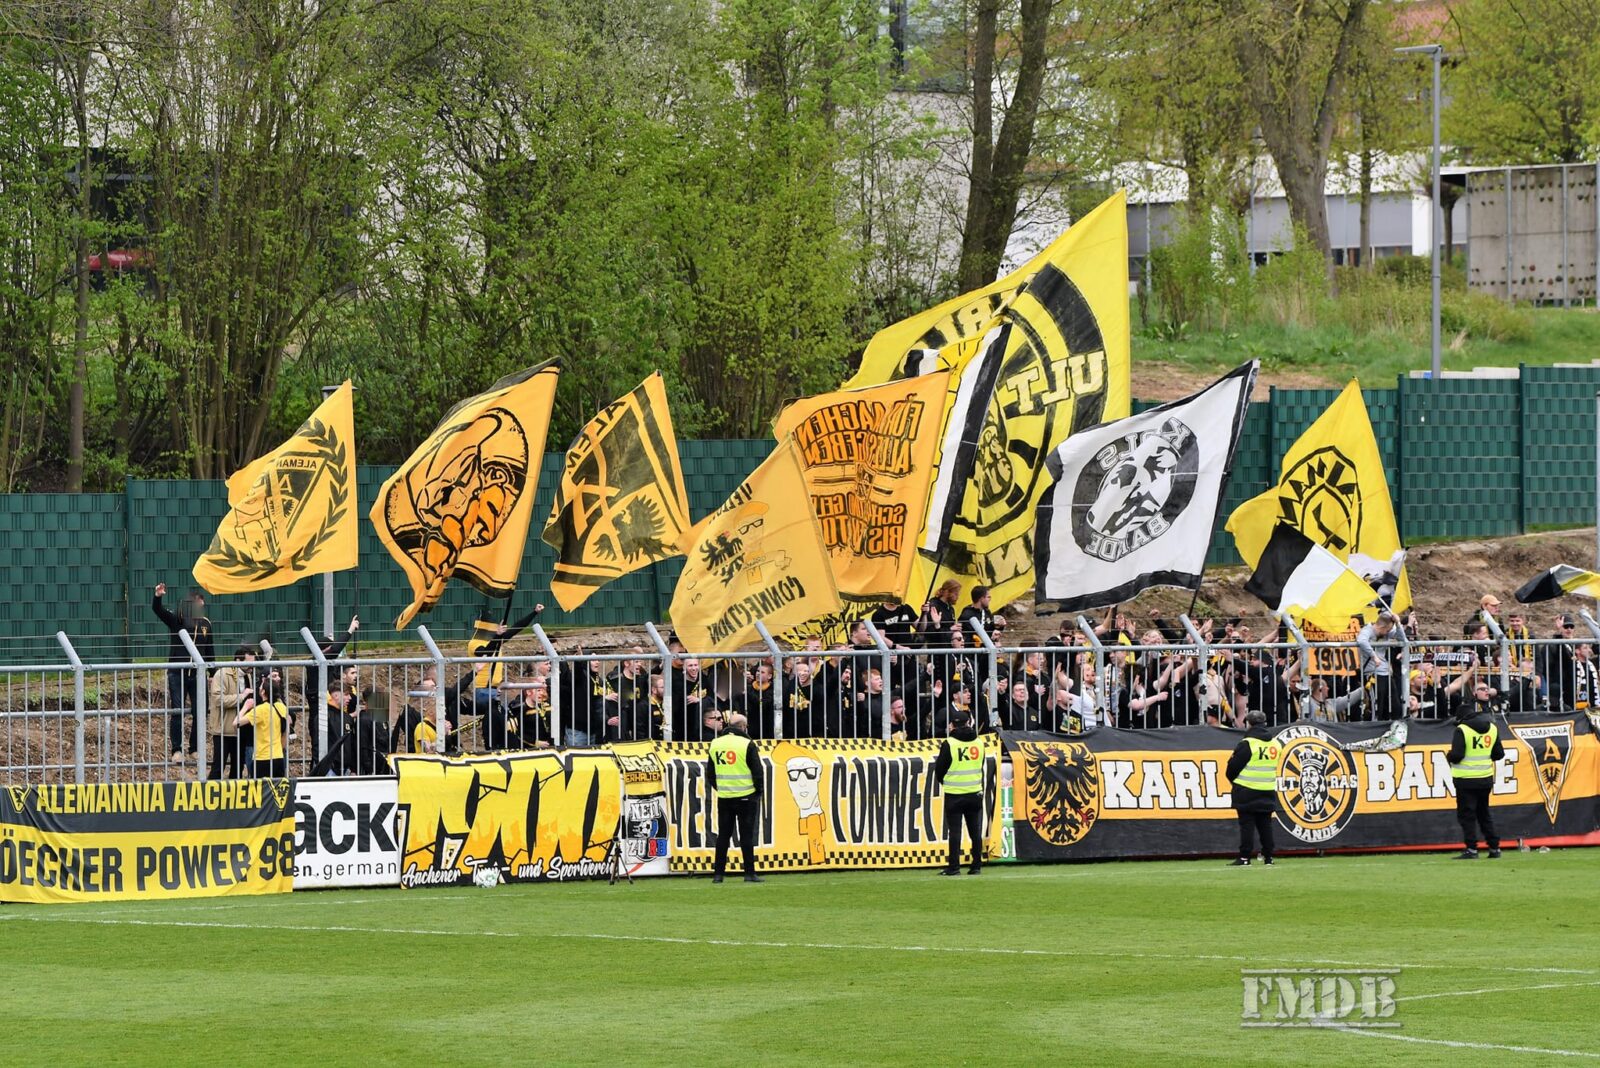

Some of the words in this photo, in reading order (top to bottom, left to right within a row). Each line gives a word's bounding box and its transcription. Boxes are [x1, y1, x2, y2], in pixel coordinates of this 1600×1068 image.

[1277, 726, 1328, 745] KARLS
[1472, 734, 1493, 749] K9
[715, 750, 737, 765] K9
[957, 745, 980, 762] K9
[1258, 746, 1278, 760] K9
[1329, 775, 1357, 790] RAS
[1364, 748, 1519, 802] BANE
[37, 782, 166, 814] ALEMANNIA
[173, 778, 263, 812] AACHEN
[1292, 822, 1340, 840] BANDE
[648, 837, 667, 857] RB
[136, 843, 252, 890] POWER
[259, 832, 296, 881] 98
[401, 863, 462, 887] Aachener
[518, 859, 543, 879] und
